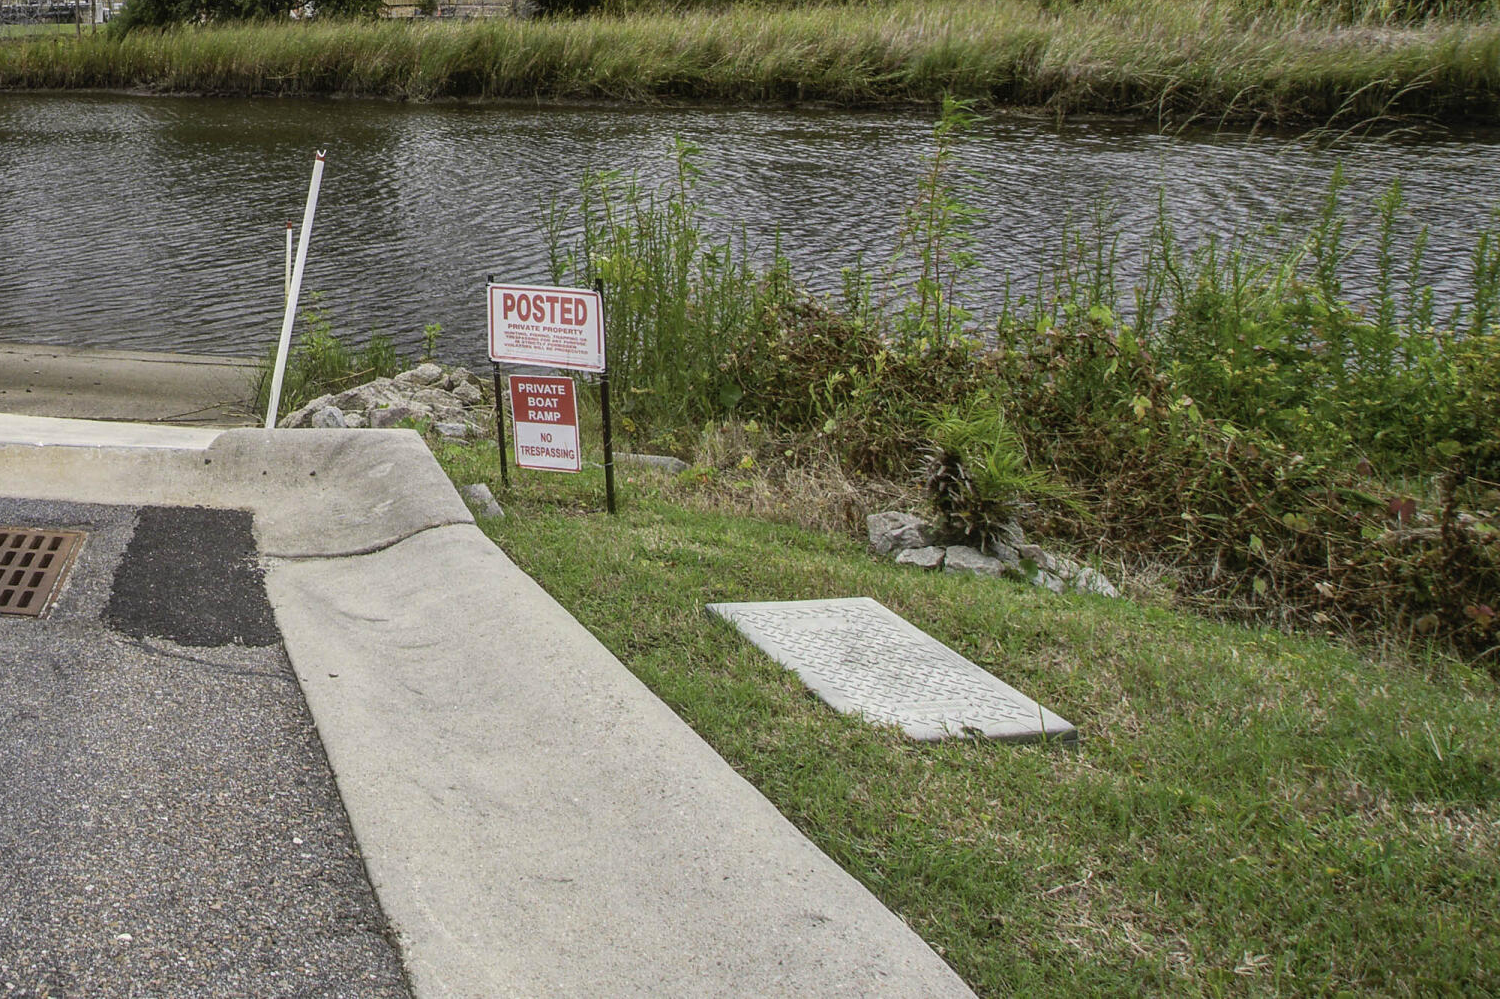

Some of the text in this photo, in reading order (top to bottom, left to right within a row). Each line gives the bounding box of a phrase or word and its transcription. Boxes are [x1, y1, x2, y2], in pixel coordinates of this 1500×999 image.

[503, 293, 587, 326] POSTED
[508, 323, 583, 335] PRIVATE PROPERTY
[518, 383, 566, 395] PRIVATE
[527, 396, 559, 408] BOAT
[528, 410, 561, 422] RAMP
[540, 432, 552, 442] NO
[520, 445, 575, 459] TRESPASSING
